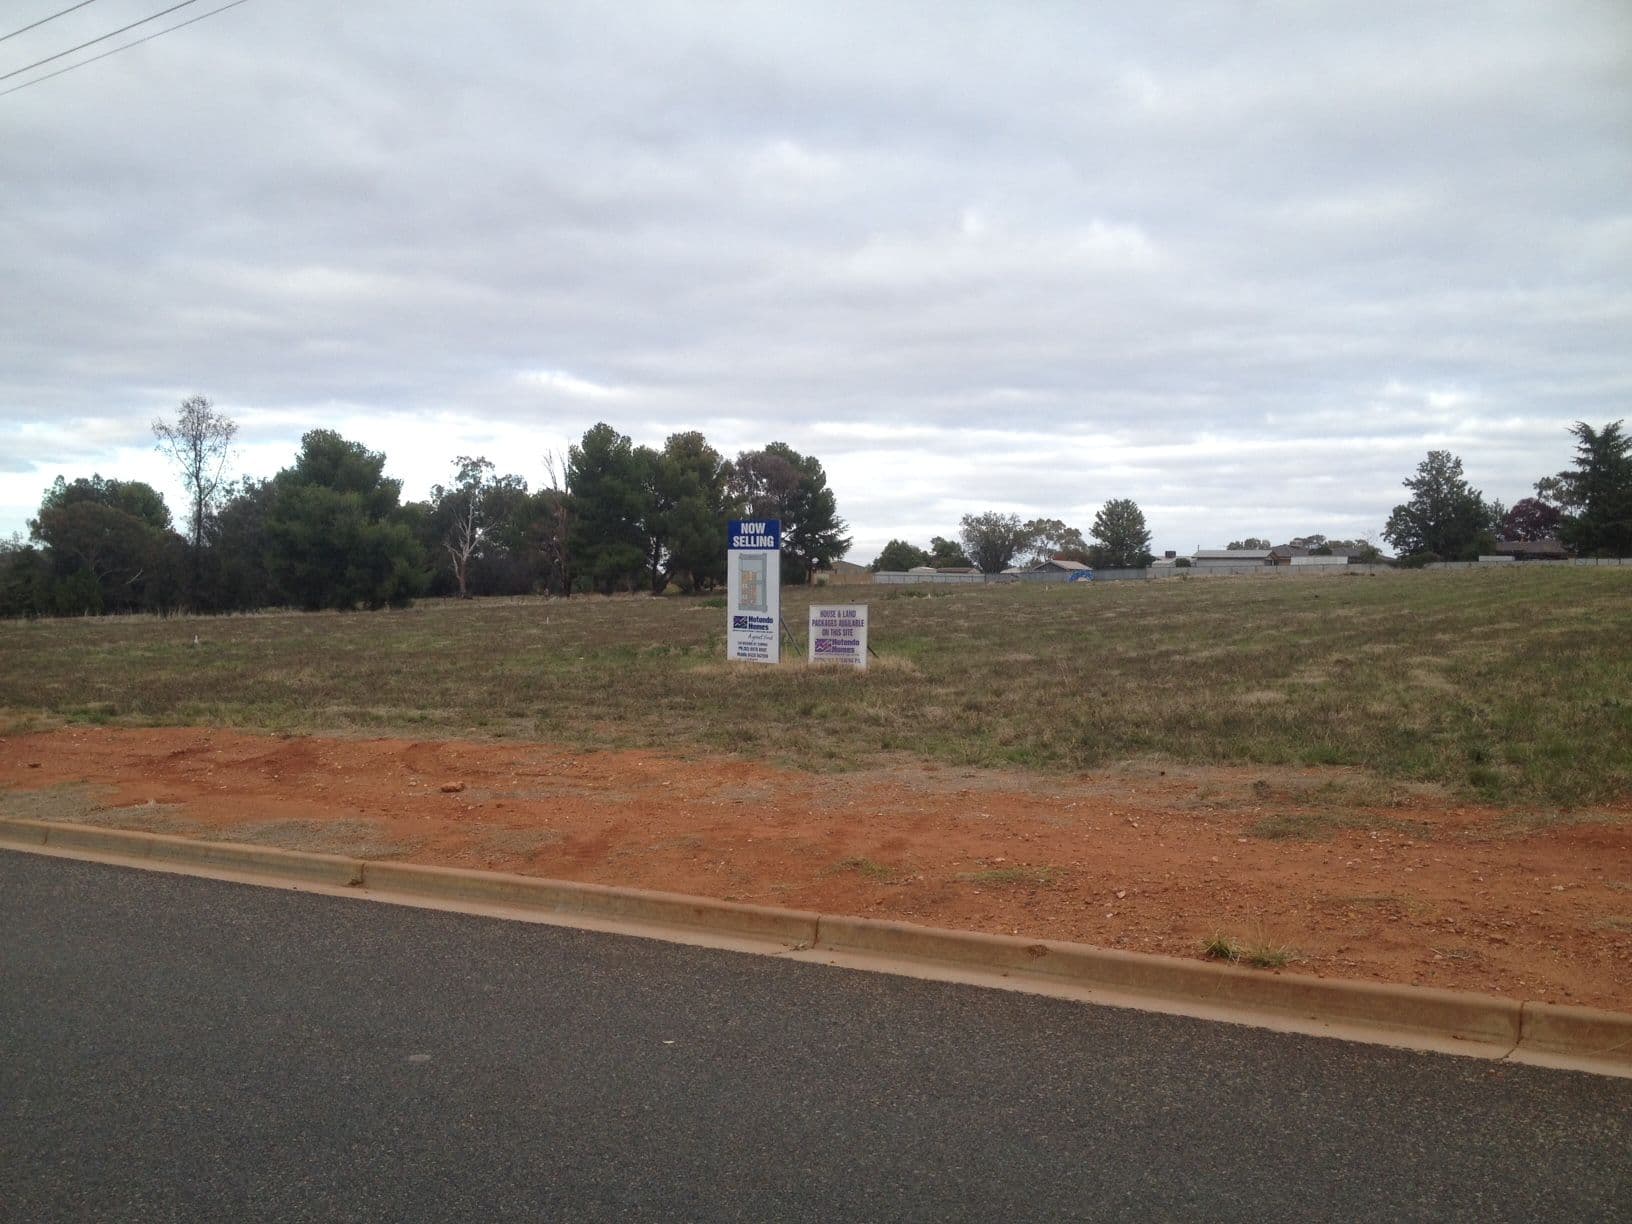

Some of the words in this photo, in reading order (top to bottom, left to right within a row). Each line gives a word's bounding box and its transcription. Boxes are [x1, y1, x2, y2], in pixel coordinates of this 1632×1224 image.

[741, 523, 766, 534] NOW
[733, 536, 774, 547] SELLING
[820, 610, 836, 618] HOUSE
[842, 610, 857, 618] LAND
[838, 619, 865, 627] AVAILABLE
[830, 628, 842, 637] THIS
[842, 628, 854, 637] SITE
